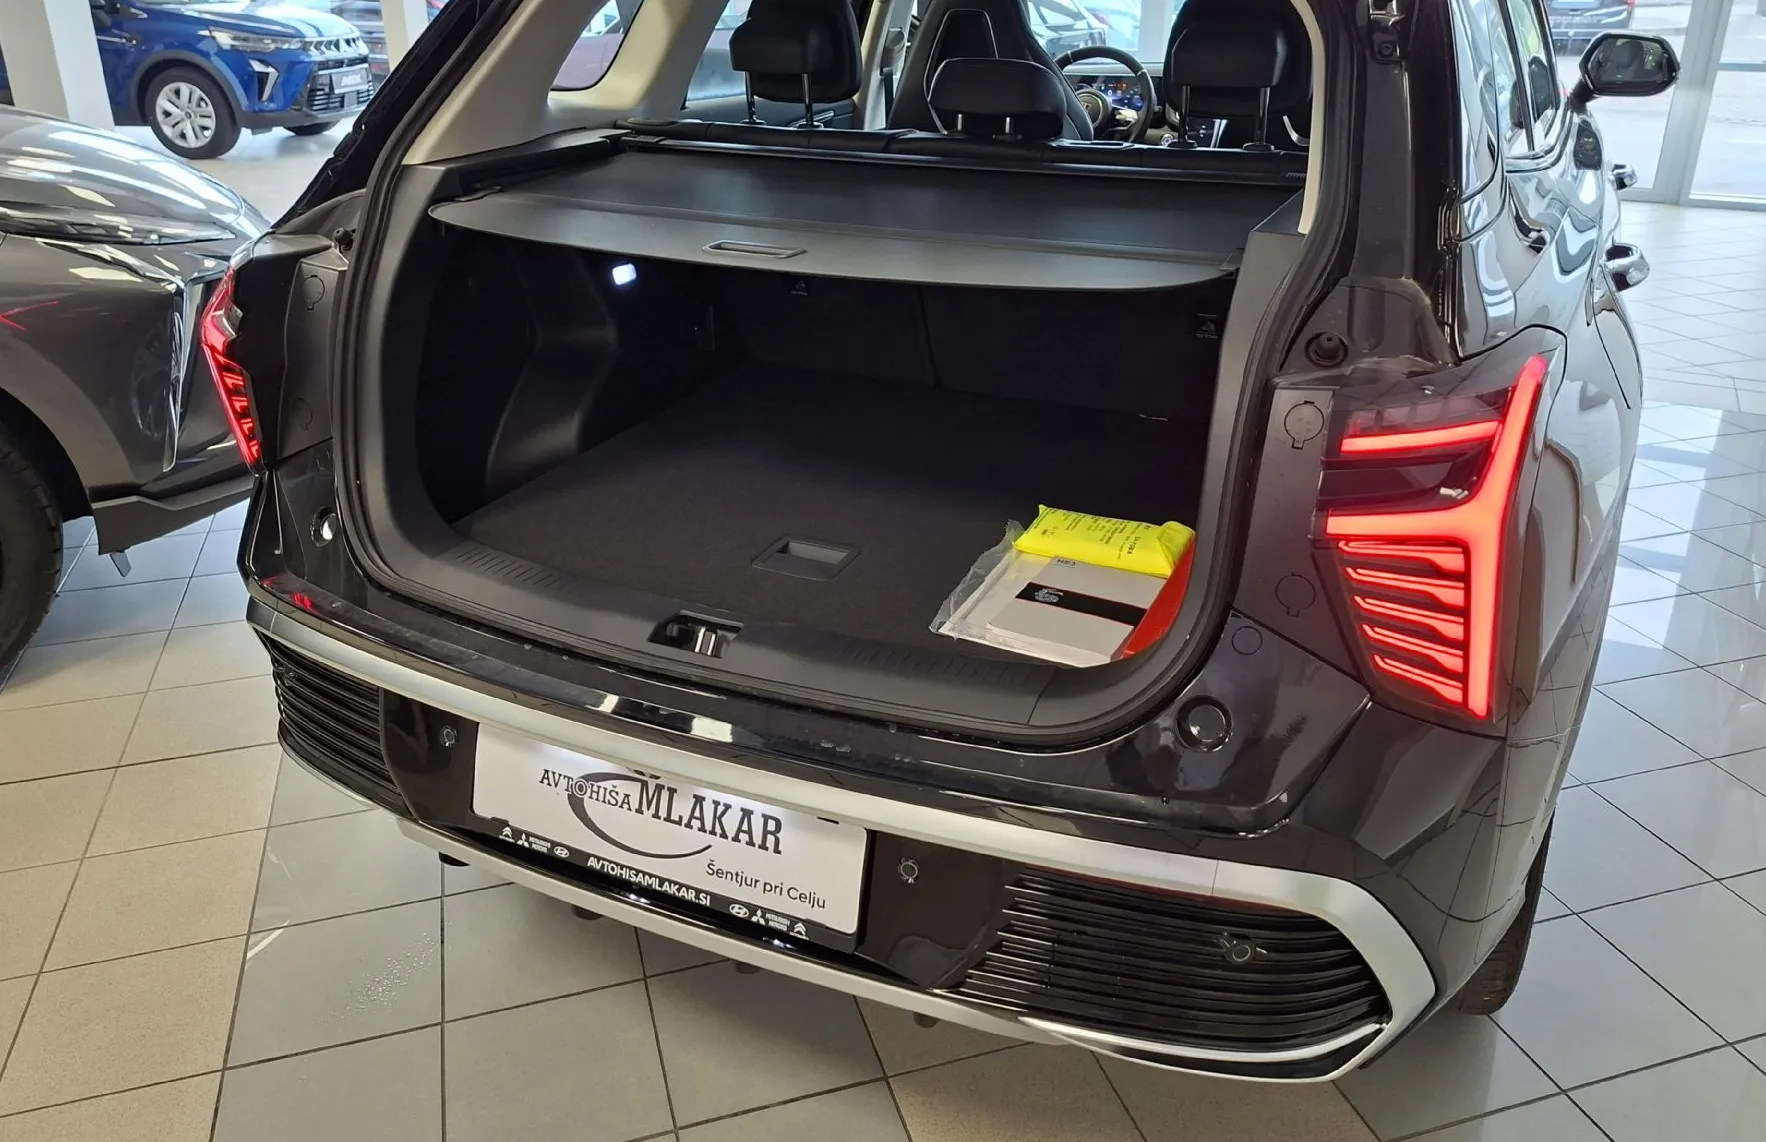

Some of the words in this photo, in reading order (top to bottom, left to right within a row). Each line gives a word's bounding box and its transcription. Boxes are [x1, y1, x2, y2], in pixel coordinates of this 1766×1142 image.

[539, 768, 632, 812] AVTOHIŠA
[635, 779, 782, 855] MLAKAR
[587, 856, 711, 907] AVTOHISAMLAKAR.SI
[706, 858, 760, 889] Šentjur
[763, 882, 784, 896] pri
[787, 886, 826, 909] Celju
